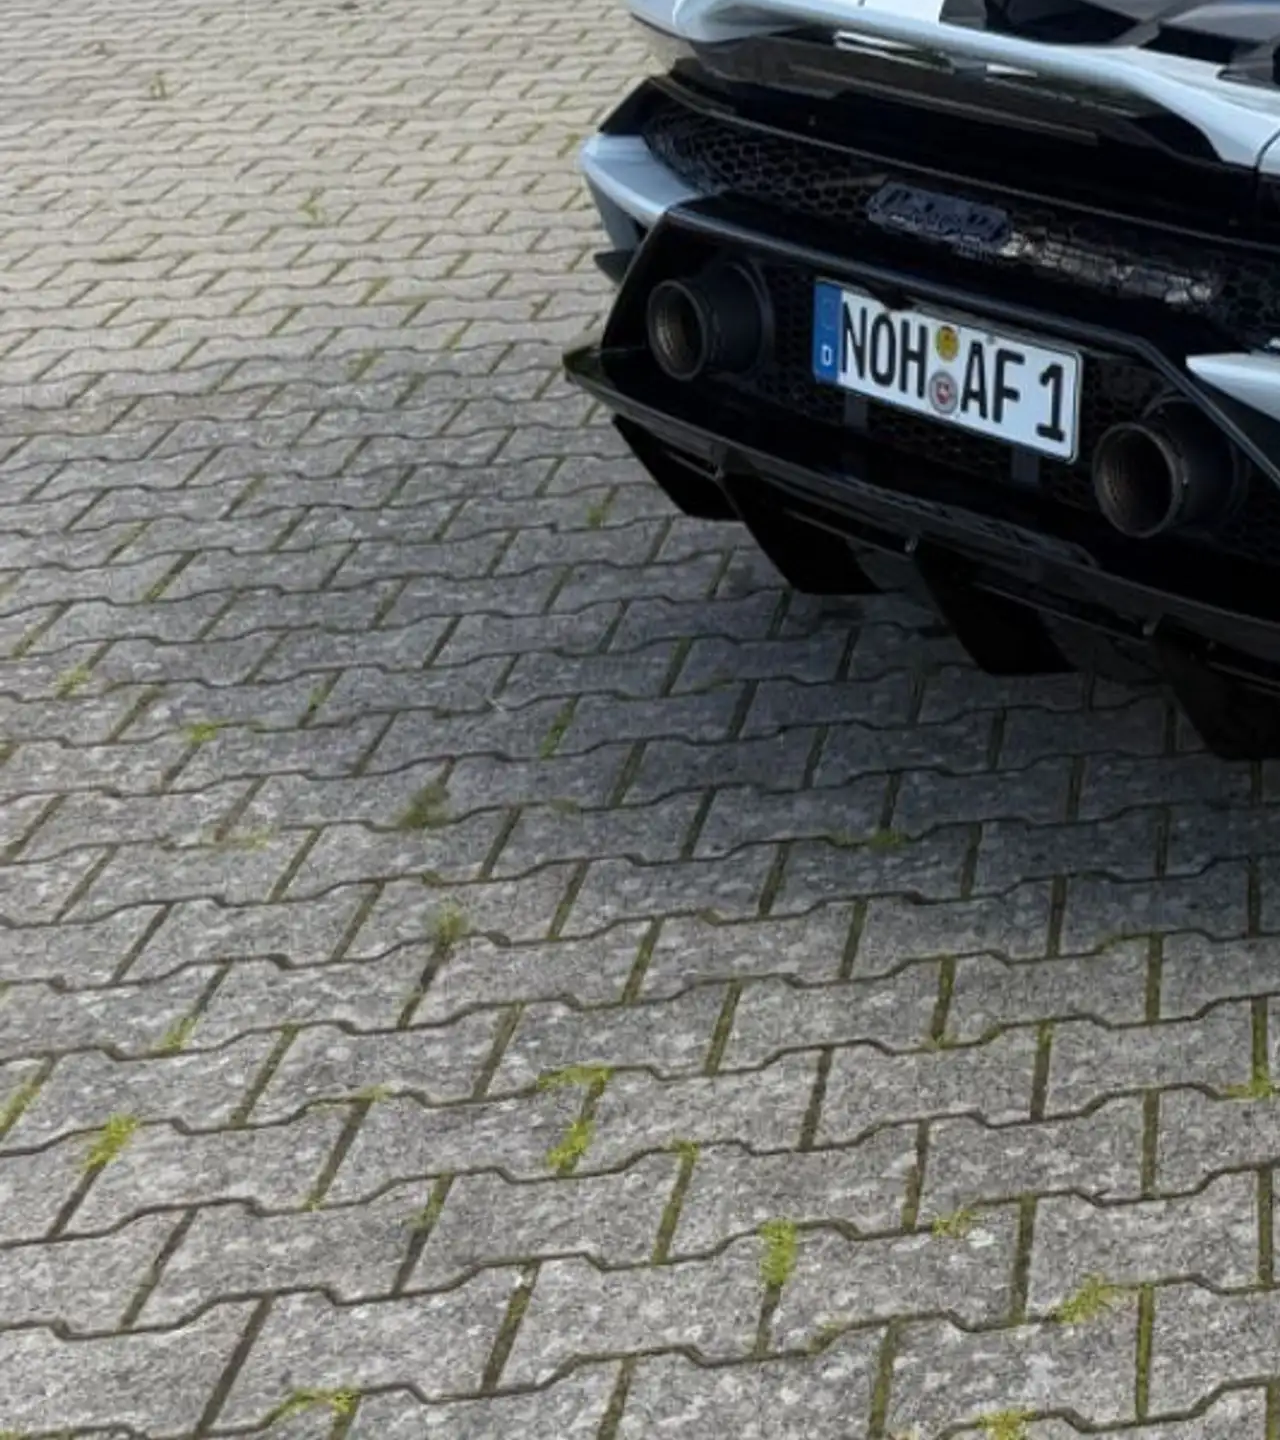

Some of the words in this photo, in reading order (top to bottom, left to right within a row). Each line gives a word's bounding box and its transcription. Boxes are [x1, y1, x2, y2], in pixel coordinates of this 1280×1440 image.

[821, 345, 833, 366] D
[841, 303, 928, 399] NOH
[960, 340, 1026, 423] AF
[1036, 363, 1066, 442] 1
